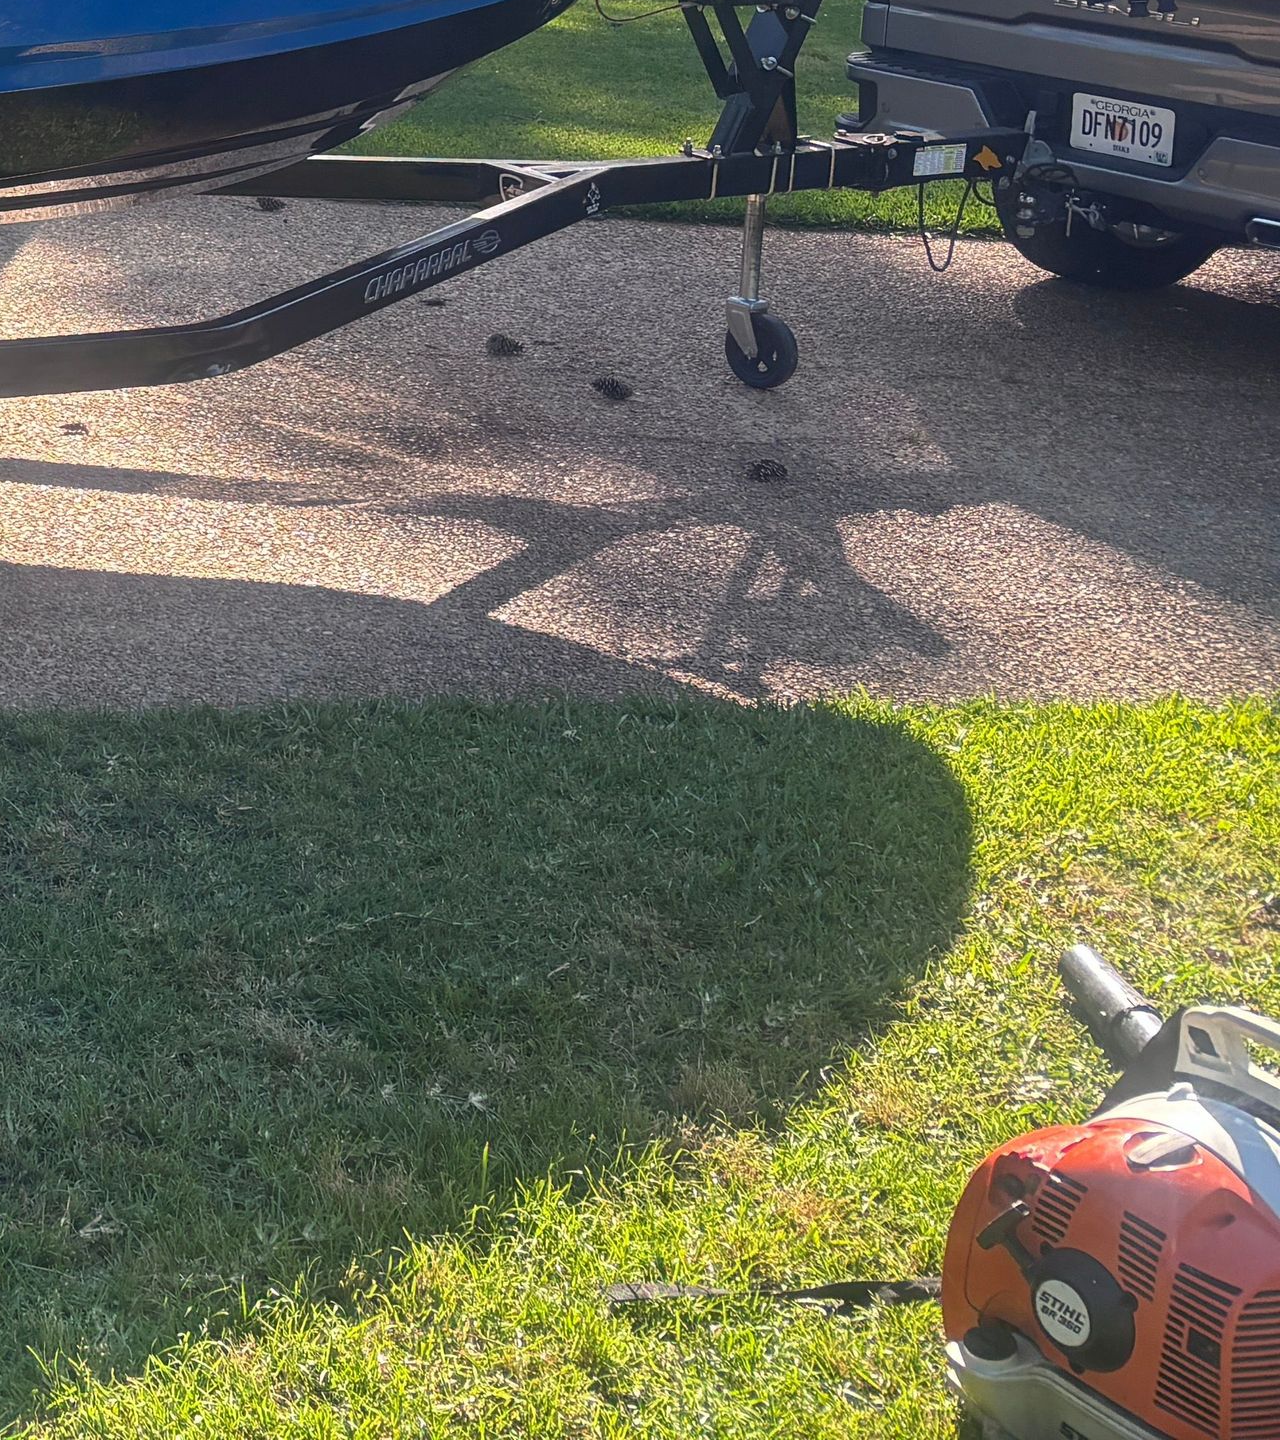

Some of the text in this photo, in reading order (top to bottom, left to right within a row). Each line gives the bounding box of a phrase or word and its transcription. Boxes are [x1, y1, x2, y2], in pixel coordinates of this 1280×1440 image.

[1095, 100, 1151, 119] GEORGIA
[1081, 109, 1163, 148] DFN7109
[364, 239, 472, 304] CHAPARRAL
[1039, 1290, 1085, 1327] STIHL
[1057, 1314, 1082, 1335] 350
